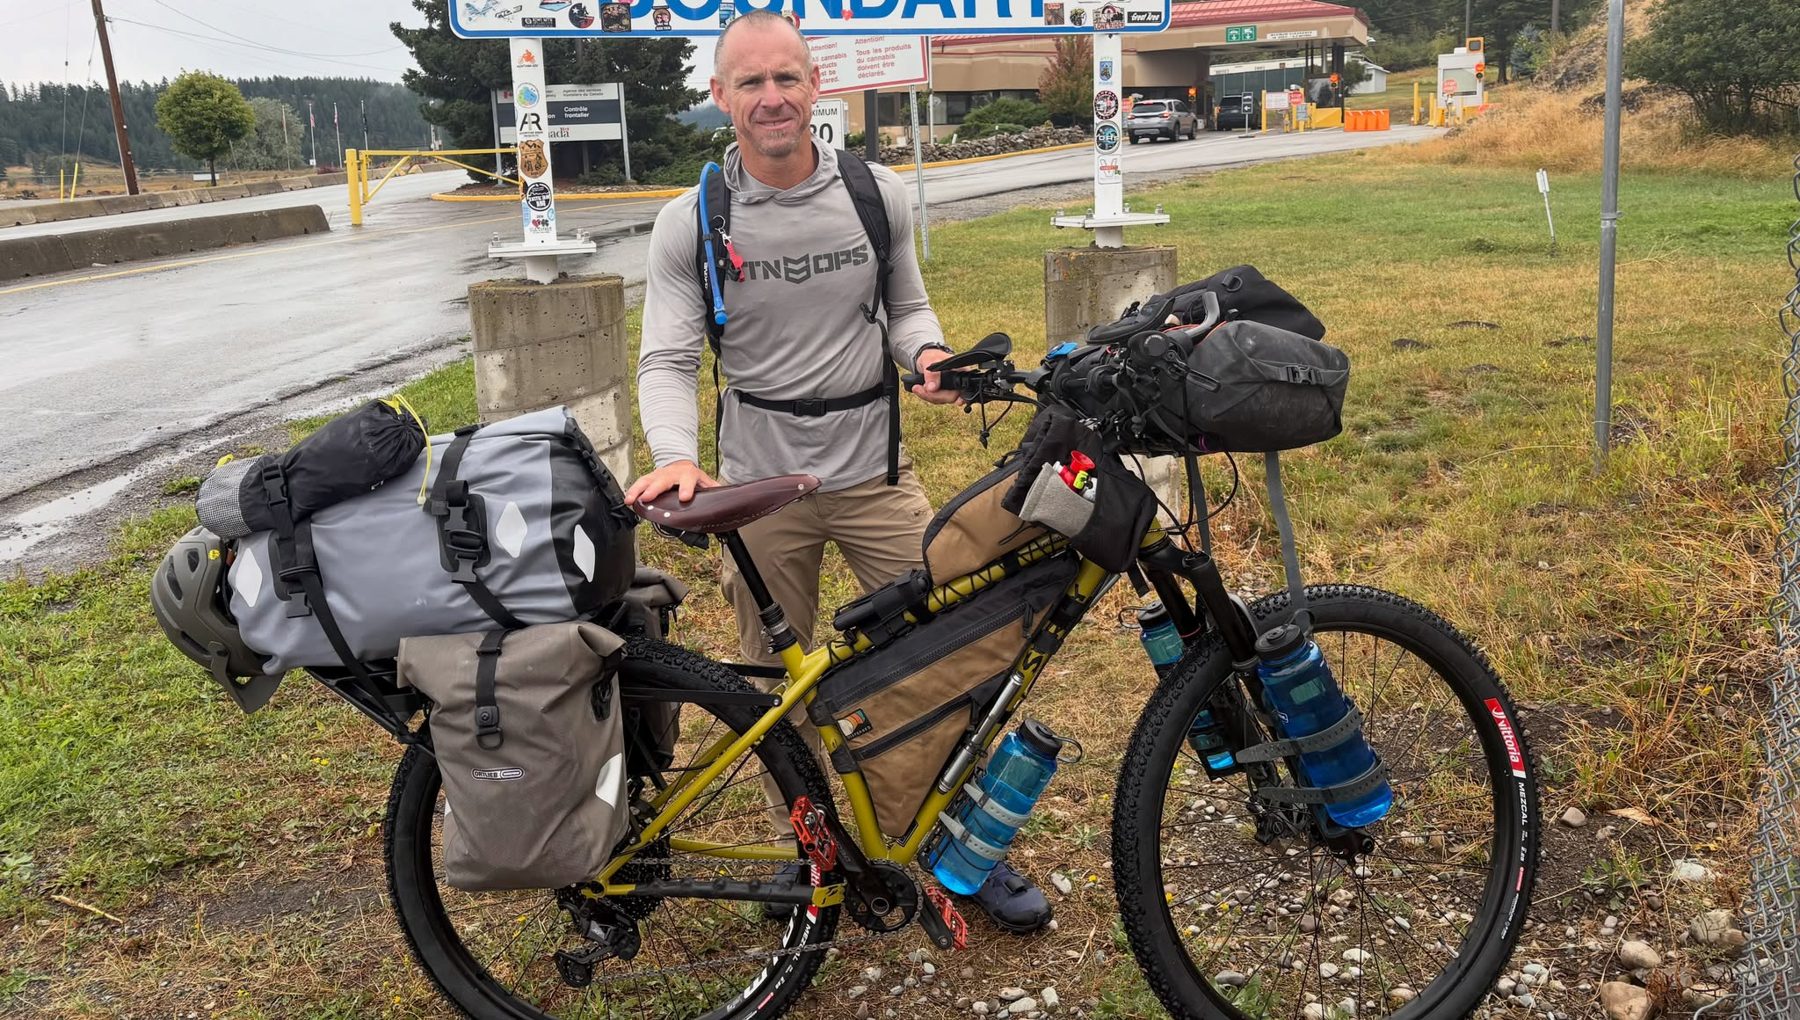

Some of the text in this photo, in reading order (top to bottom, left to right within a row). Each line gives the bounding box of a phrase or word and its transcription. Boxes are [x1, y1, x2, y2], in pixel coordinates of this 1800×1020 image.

[884, 44, 912, 54] produits
[821, 53, 847, 61] cannabis
[866, 54, 895, 62] cannabis
[857, 63, 880, 71] doivent
[812, 244, 869, 275] OPS
[1498, 719, 1521, 763] vittoria
[1518, 782, 1529, 826] MEZCAL
